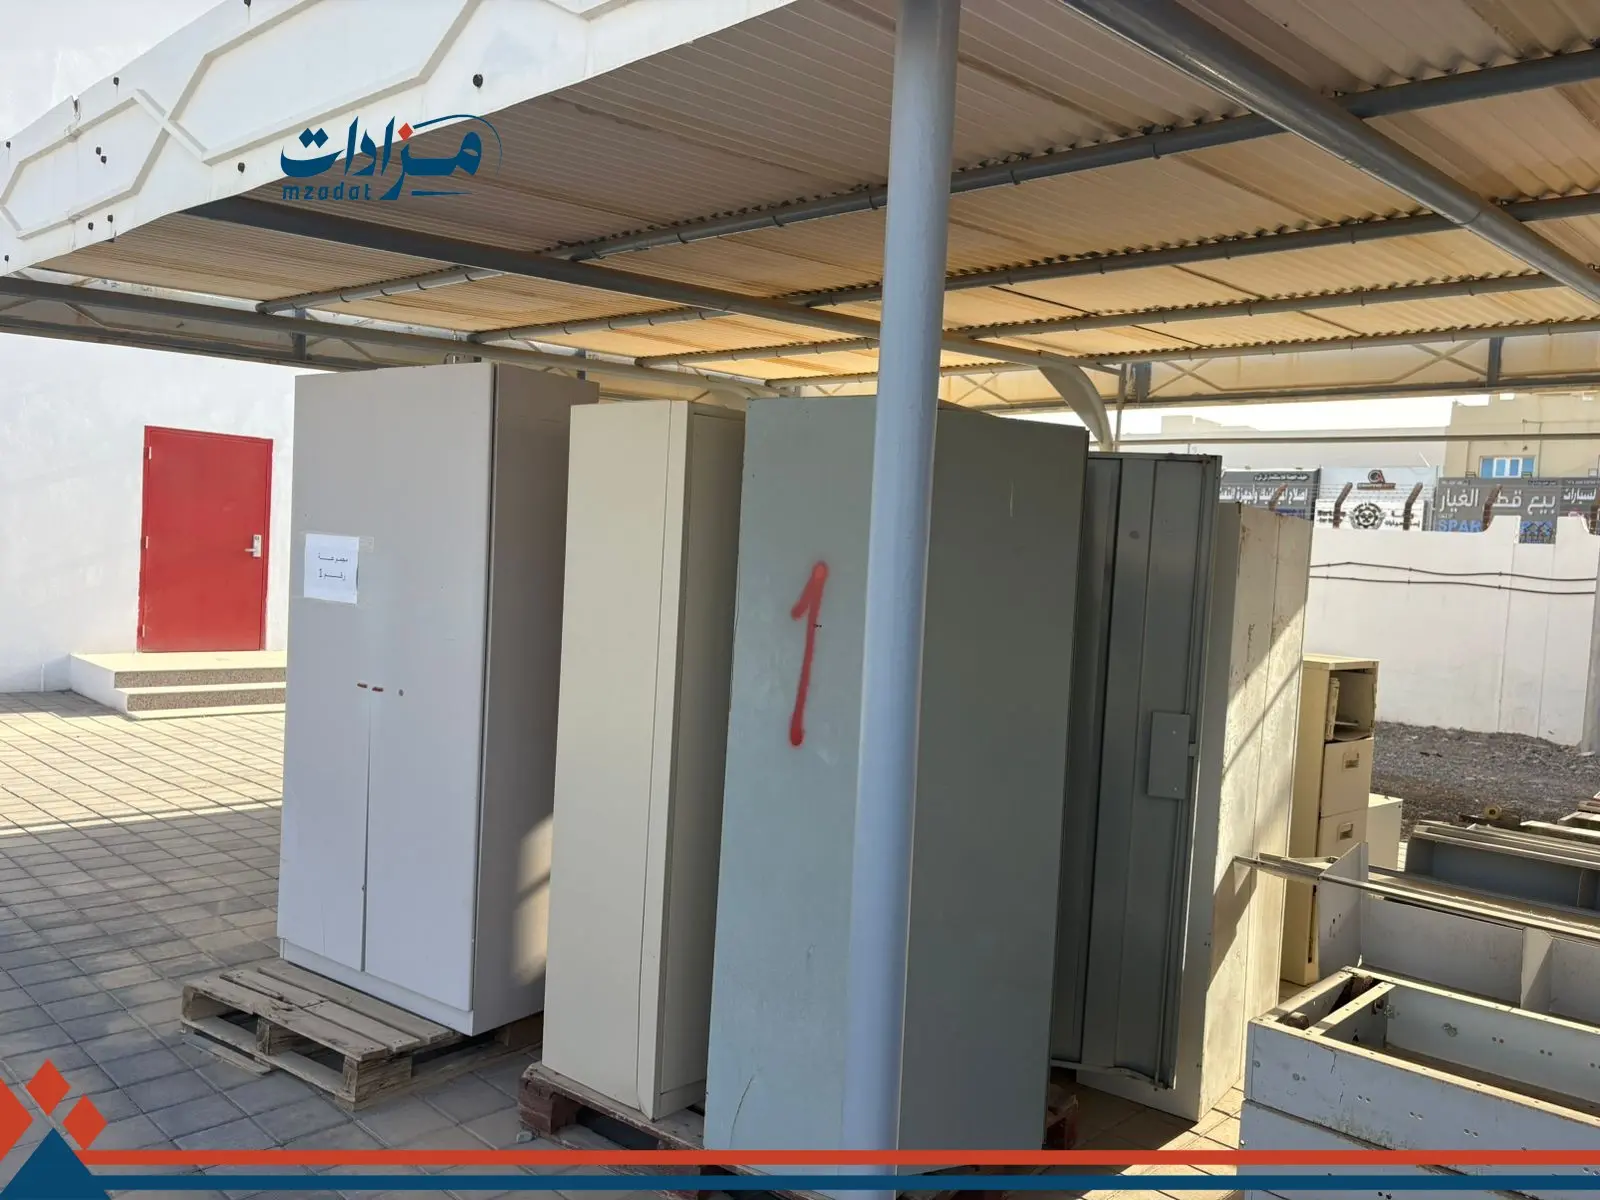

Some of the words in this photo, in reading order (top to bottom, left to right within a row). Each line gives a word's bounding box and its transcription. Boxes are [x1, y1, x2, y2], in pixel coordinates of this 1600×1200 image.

[1439, 487, 1479, 513] الغيار
[1487, 489, 1522, 508] قط
[1527, 494, 1556, 515] بيع
[1438, 519, 1482, 532] SPAR
[790, 560, 828, 746] 1
